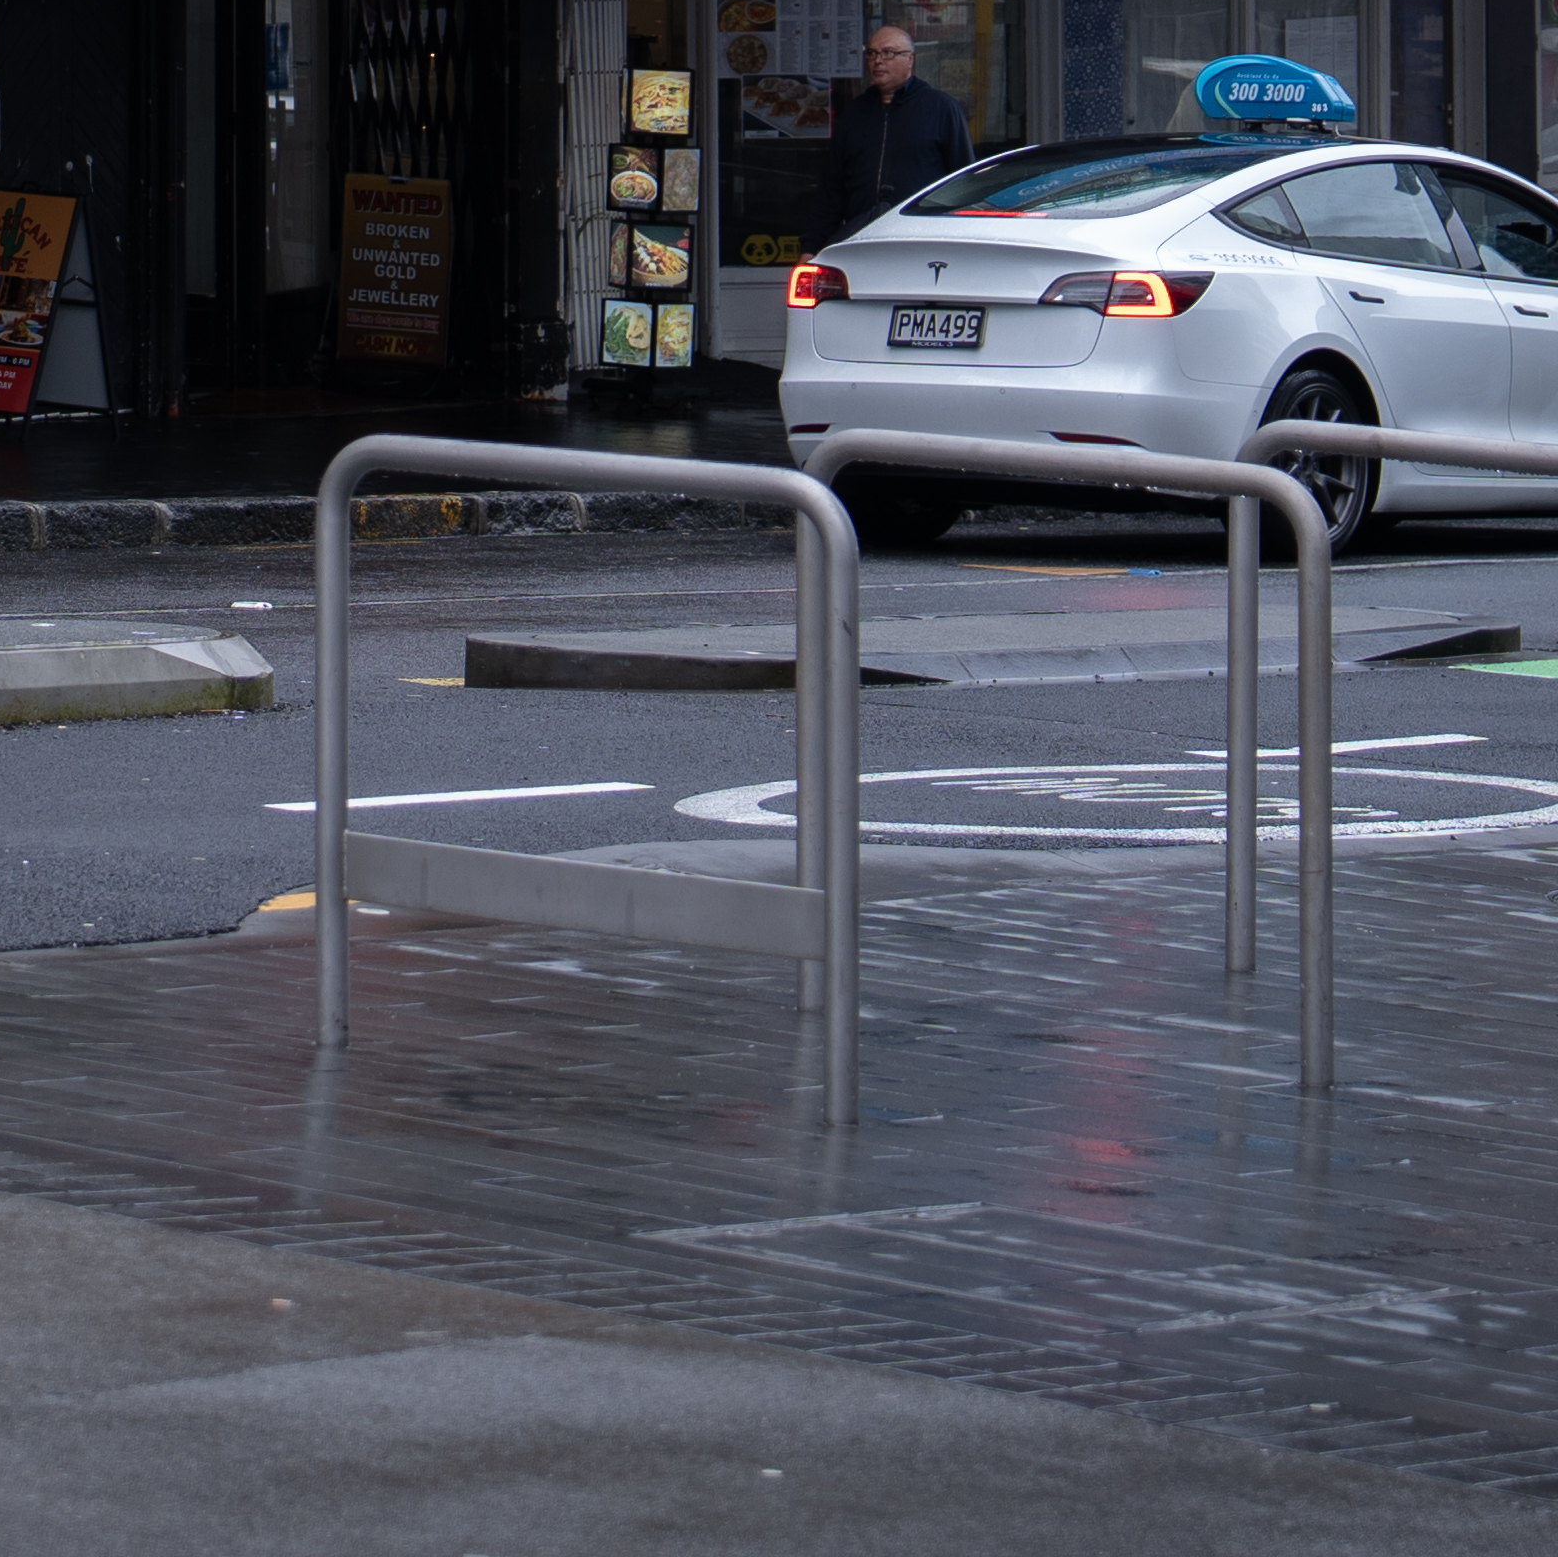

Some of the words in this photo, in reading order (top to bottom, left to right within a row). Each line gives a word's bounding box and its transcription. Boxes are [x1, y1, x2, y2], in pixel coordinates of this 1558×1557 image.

[1227, 81, 1260, 103] 300
[1261, 81, 1306, 104] 3000
[351, 188, 445, 218] WANTED
[364, 222, 431, 241] BROKEN
[351, 246, 442, 267] UNWANTED
[373, 264, 418, 281] GOLD
[347, 288, 441, 309] JEWELLERY
[896, 311, 982, 341] PMA499
[352, 334, 394, 356] CASH
